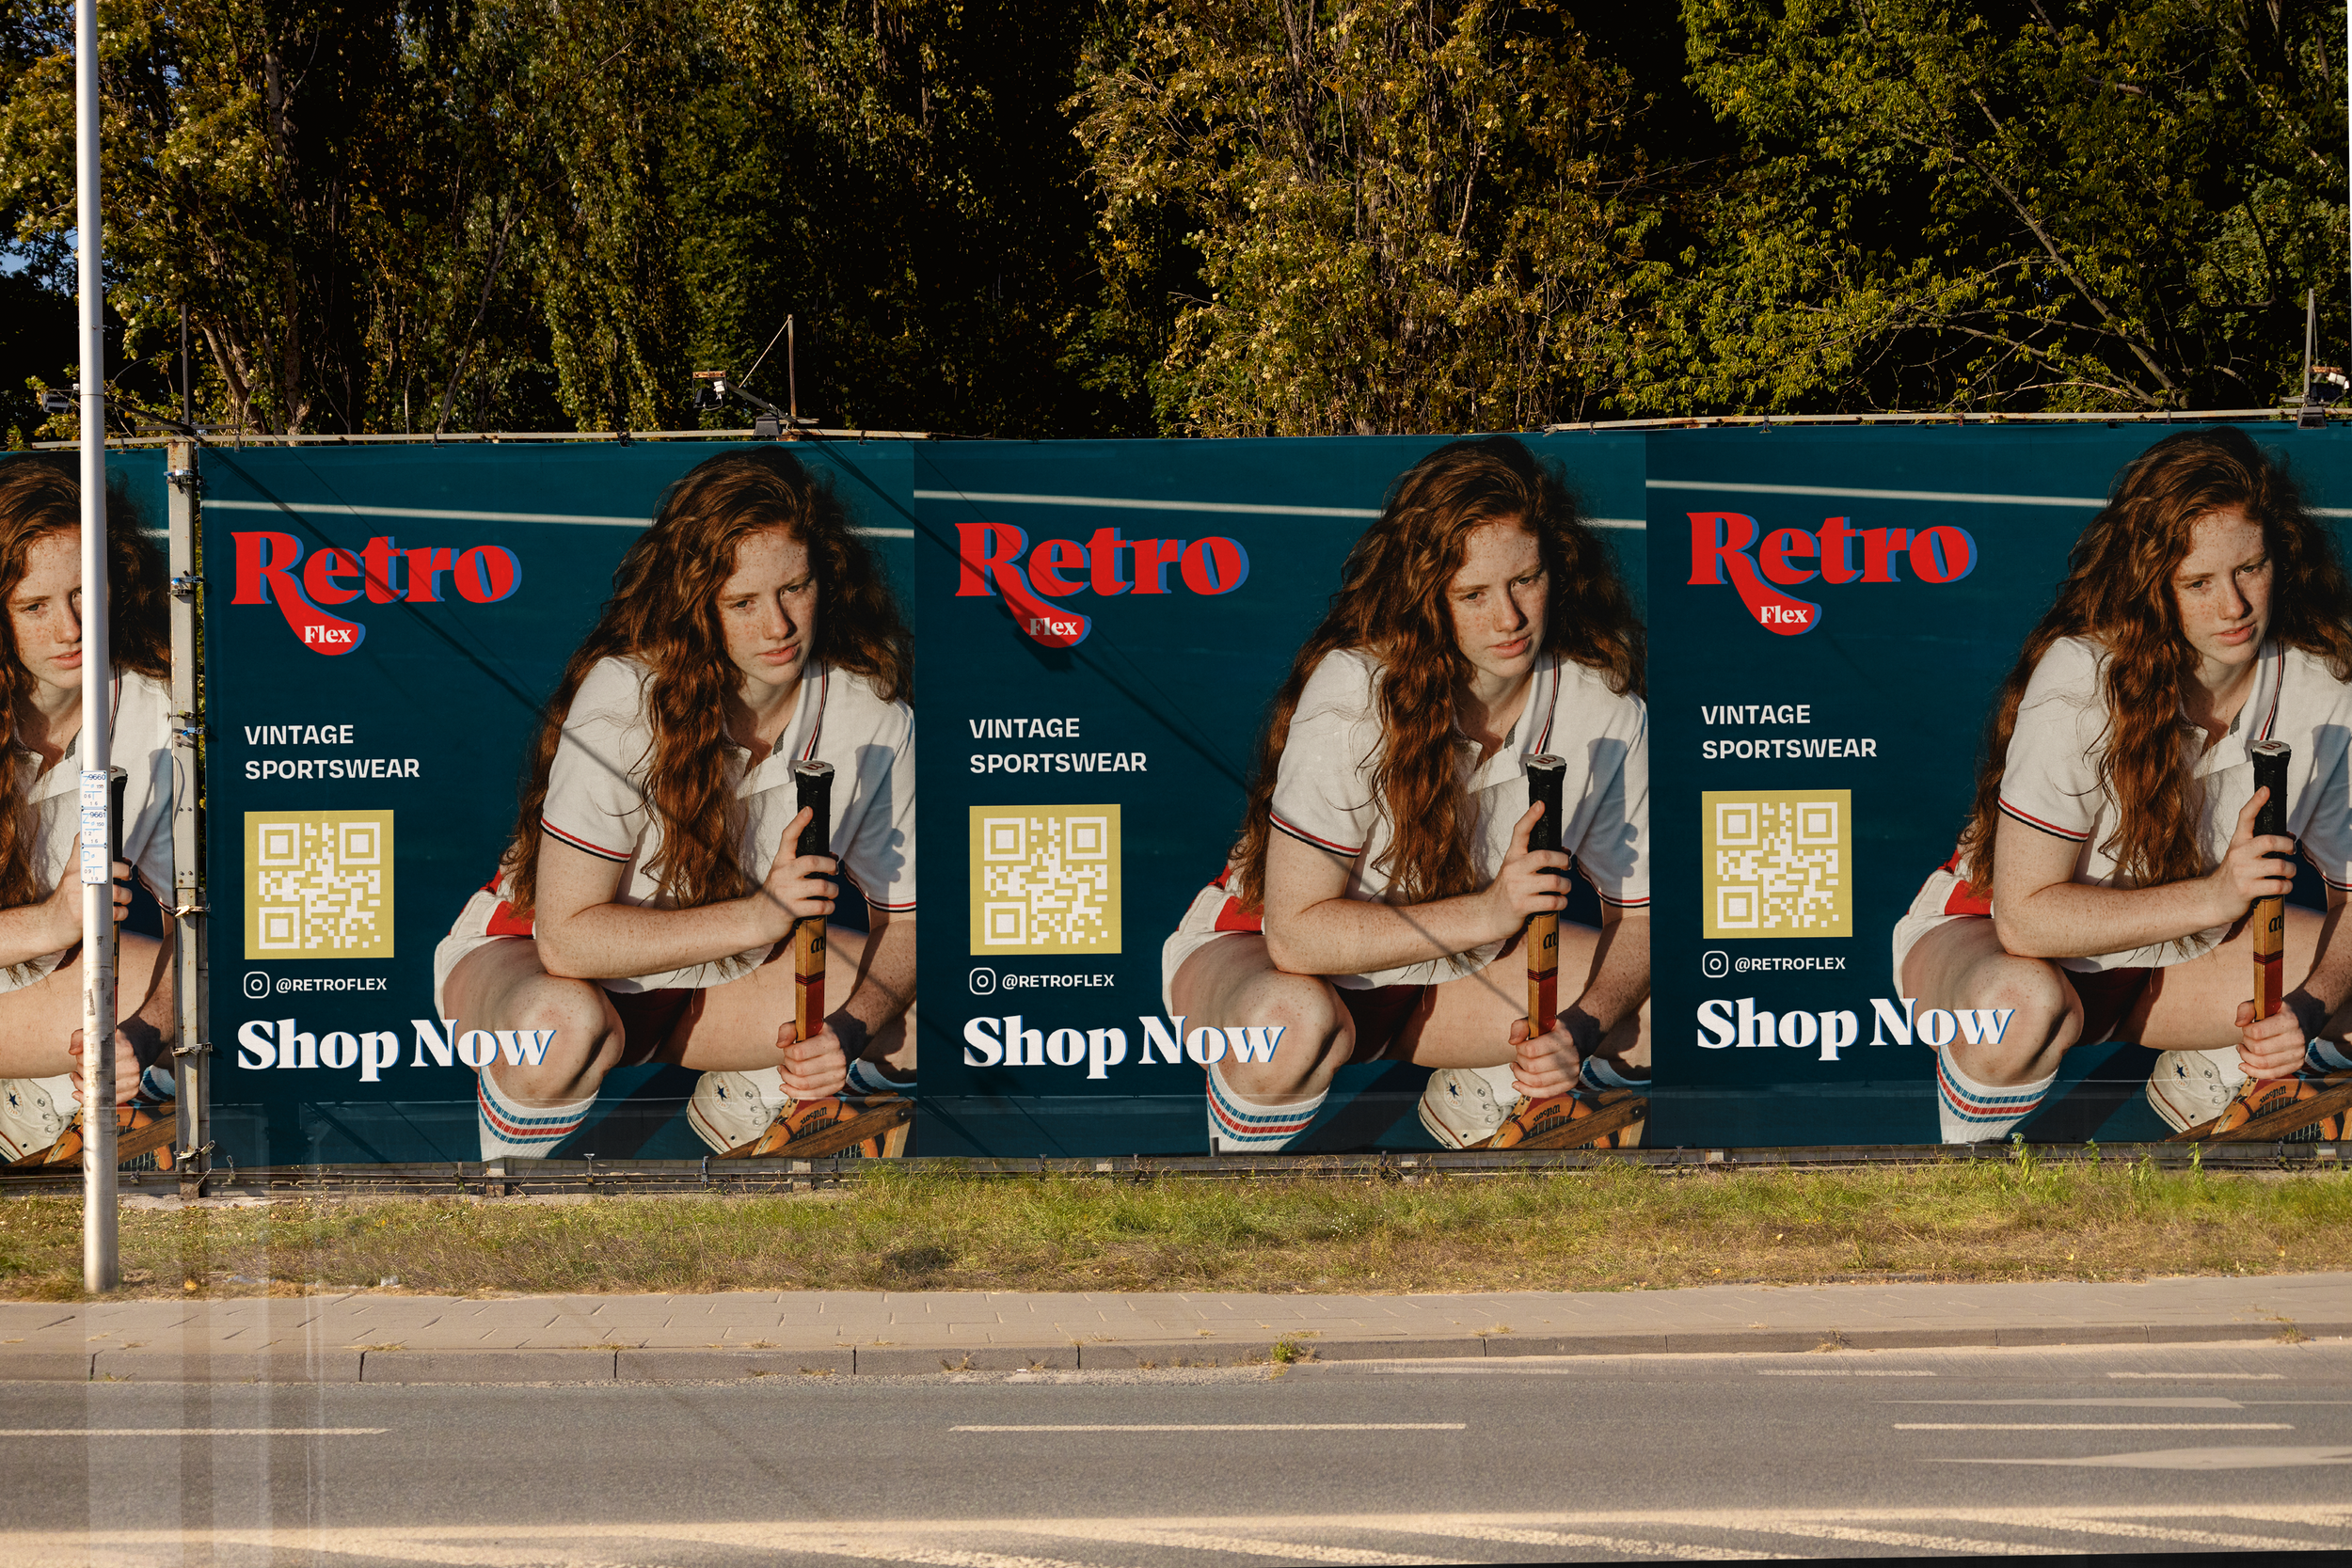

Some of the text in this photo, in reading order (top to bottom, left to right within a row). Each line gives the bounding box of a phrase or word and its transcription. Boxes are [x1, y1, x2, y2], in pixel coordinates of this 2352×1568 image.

[1686, 511, 1978, 636] Retro
[230, 531, 522, 656] Retro
[955, 522, 1249, 648] Retro
[1760, 605, 1808, 624] Flex
[304, 626, 352, 643] Flex
[1029, 617, 1078, 636] Flex
[1701, 705, 1811, 725] VINTAGE
[244, 724, 355, 745] VINTAGE
[969, 718, 1081, 738] VINTAGE
[1702, 738, 1878, 759] SPORTSWEAR
[245, 758, 421, 780] SPORTSWEAR
[970, 752, 1148, 773] SPORTSWEAR
[1734, 957, 1846, 973] @RETROFLEX
[276, 977, 388, 993] @RETROFLEX
[1002, 973, 1115, 990] @RETROFLEX
[1696, 997, 2015, 1061] Shop Now
[237, 1018, 557, 1083] Shop Now
[963, 1015, 1287, 1080] Shop Now
[2259, 1085, 2286, 1106] Wilson
[800, 1106, 827, 1128] Wilson
[1533, 1103, 1560, 1125] Wilson
